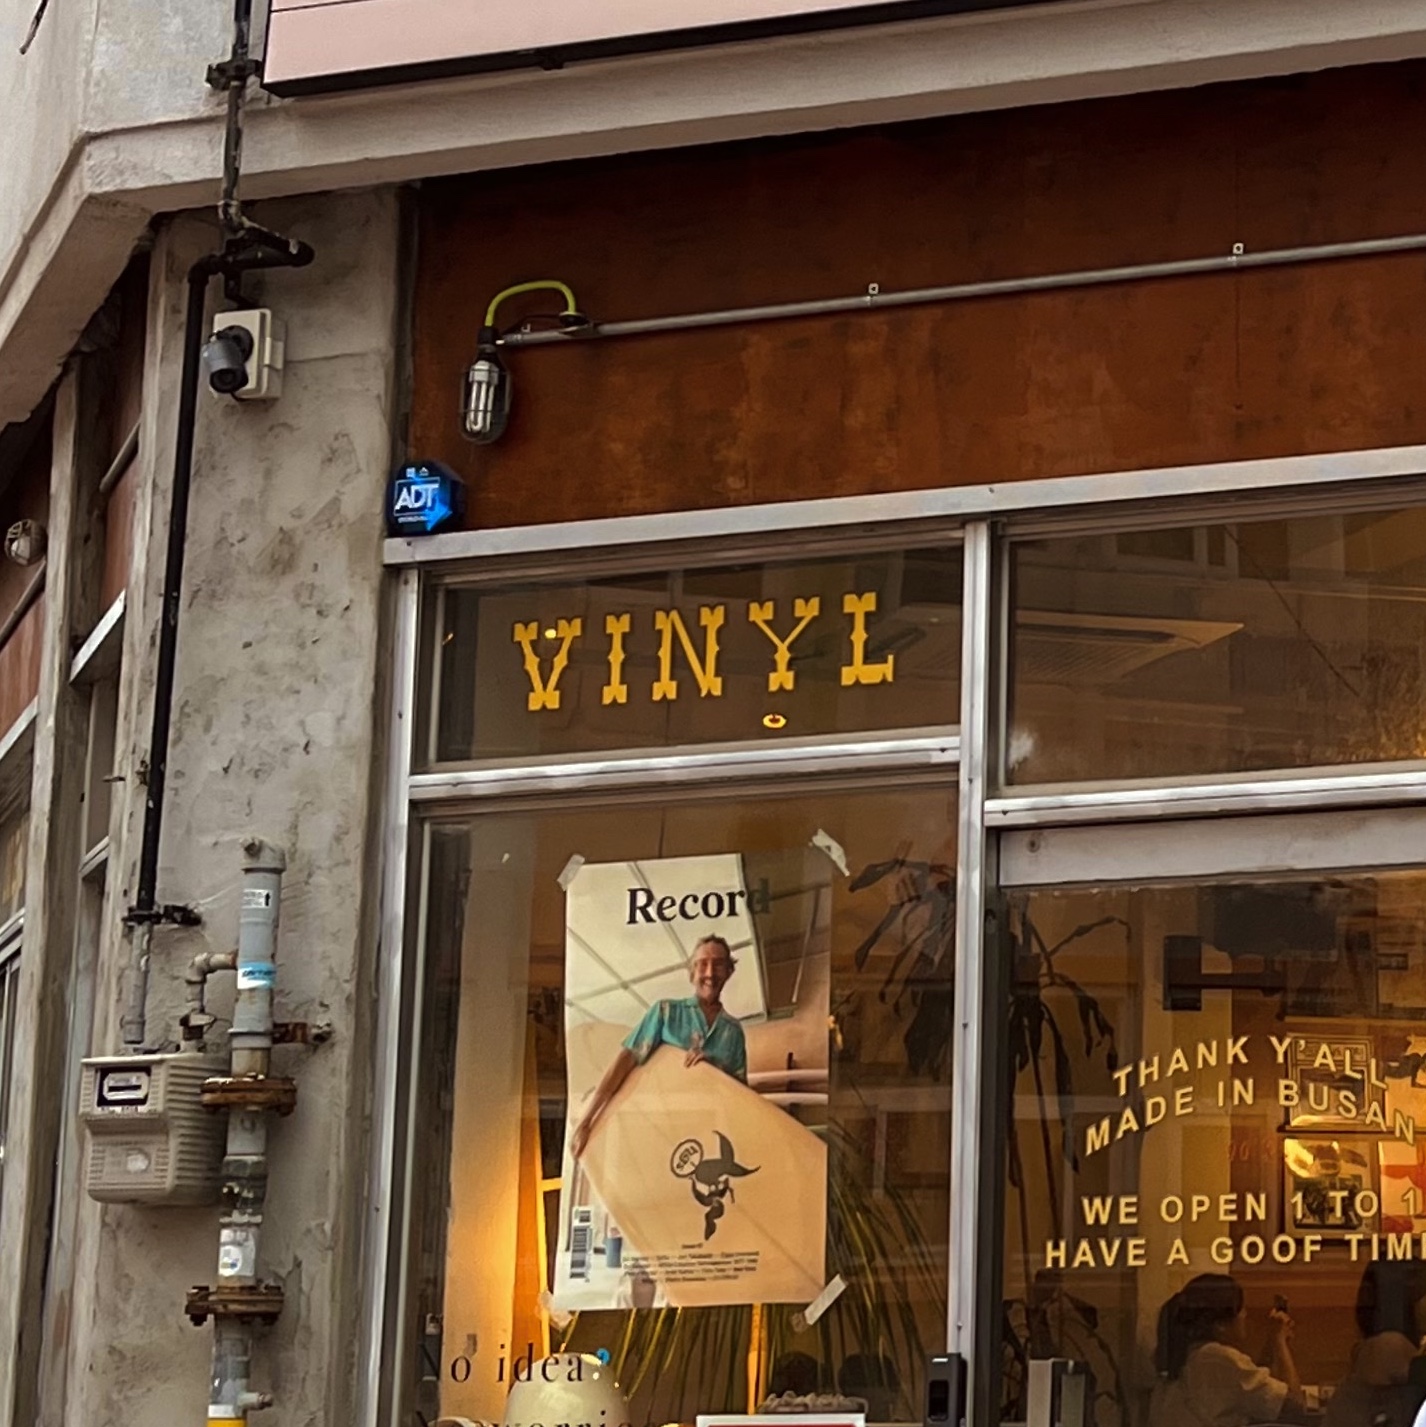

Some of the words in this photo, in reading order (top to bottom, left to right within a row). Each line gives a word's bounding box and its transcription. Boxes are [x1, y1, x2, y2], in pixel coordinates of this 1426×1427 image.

[394, 483, 439, 510] ADT
[513, 592, 894, 711] VINYL
[626, 877, 771, 925] Record
[1112, 1035, 1251, 1098] THANK
[1267, 1034, 1390, 1090] Y'ALL
[1084, 1086, 1195, 1157] MADE
[1217, 1078, 1255, 1107] IN
[1277, 1078, 1417, 1147] BUSAN
[1082, 1196, 1139, 1226] WE
[1160, 1191, 1268, 1225] OPEN
[1290, 1190, 1305, 1219] 1
[1329, 1190, 1380, 1219] TO
[1402, 1188, 1417, 1216] 1
[1045, 1239, 1148, 1269] HAVE
[1167, 1236, 1190, 1265] A
[1210, 1233, 1324, 1265] GOOF
[417, 1342, 472, 1384] No
[496, 1342, 584, 1384] idea
